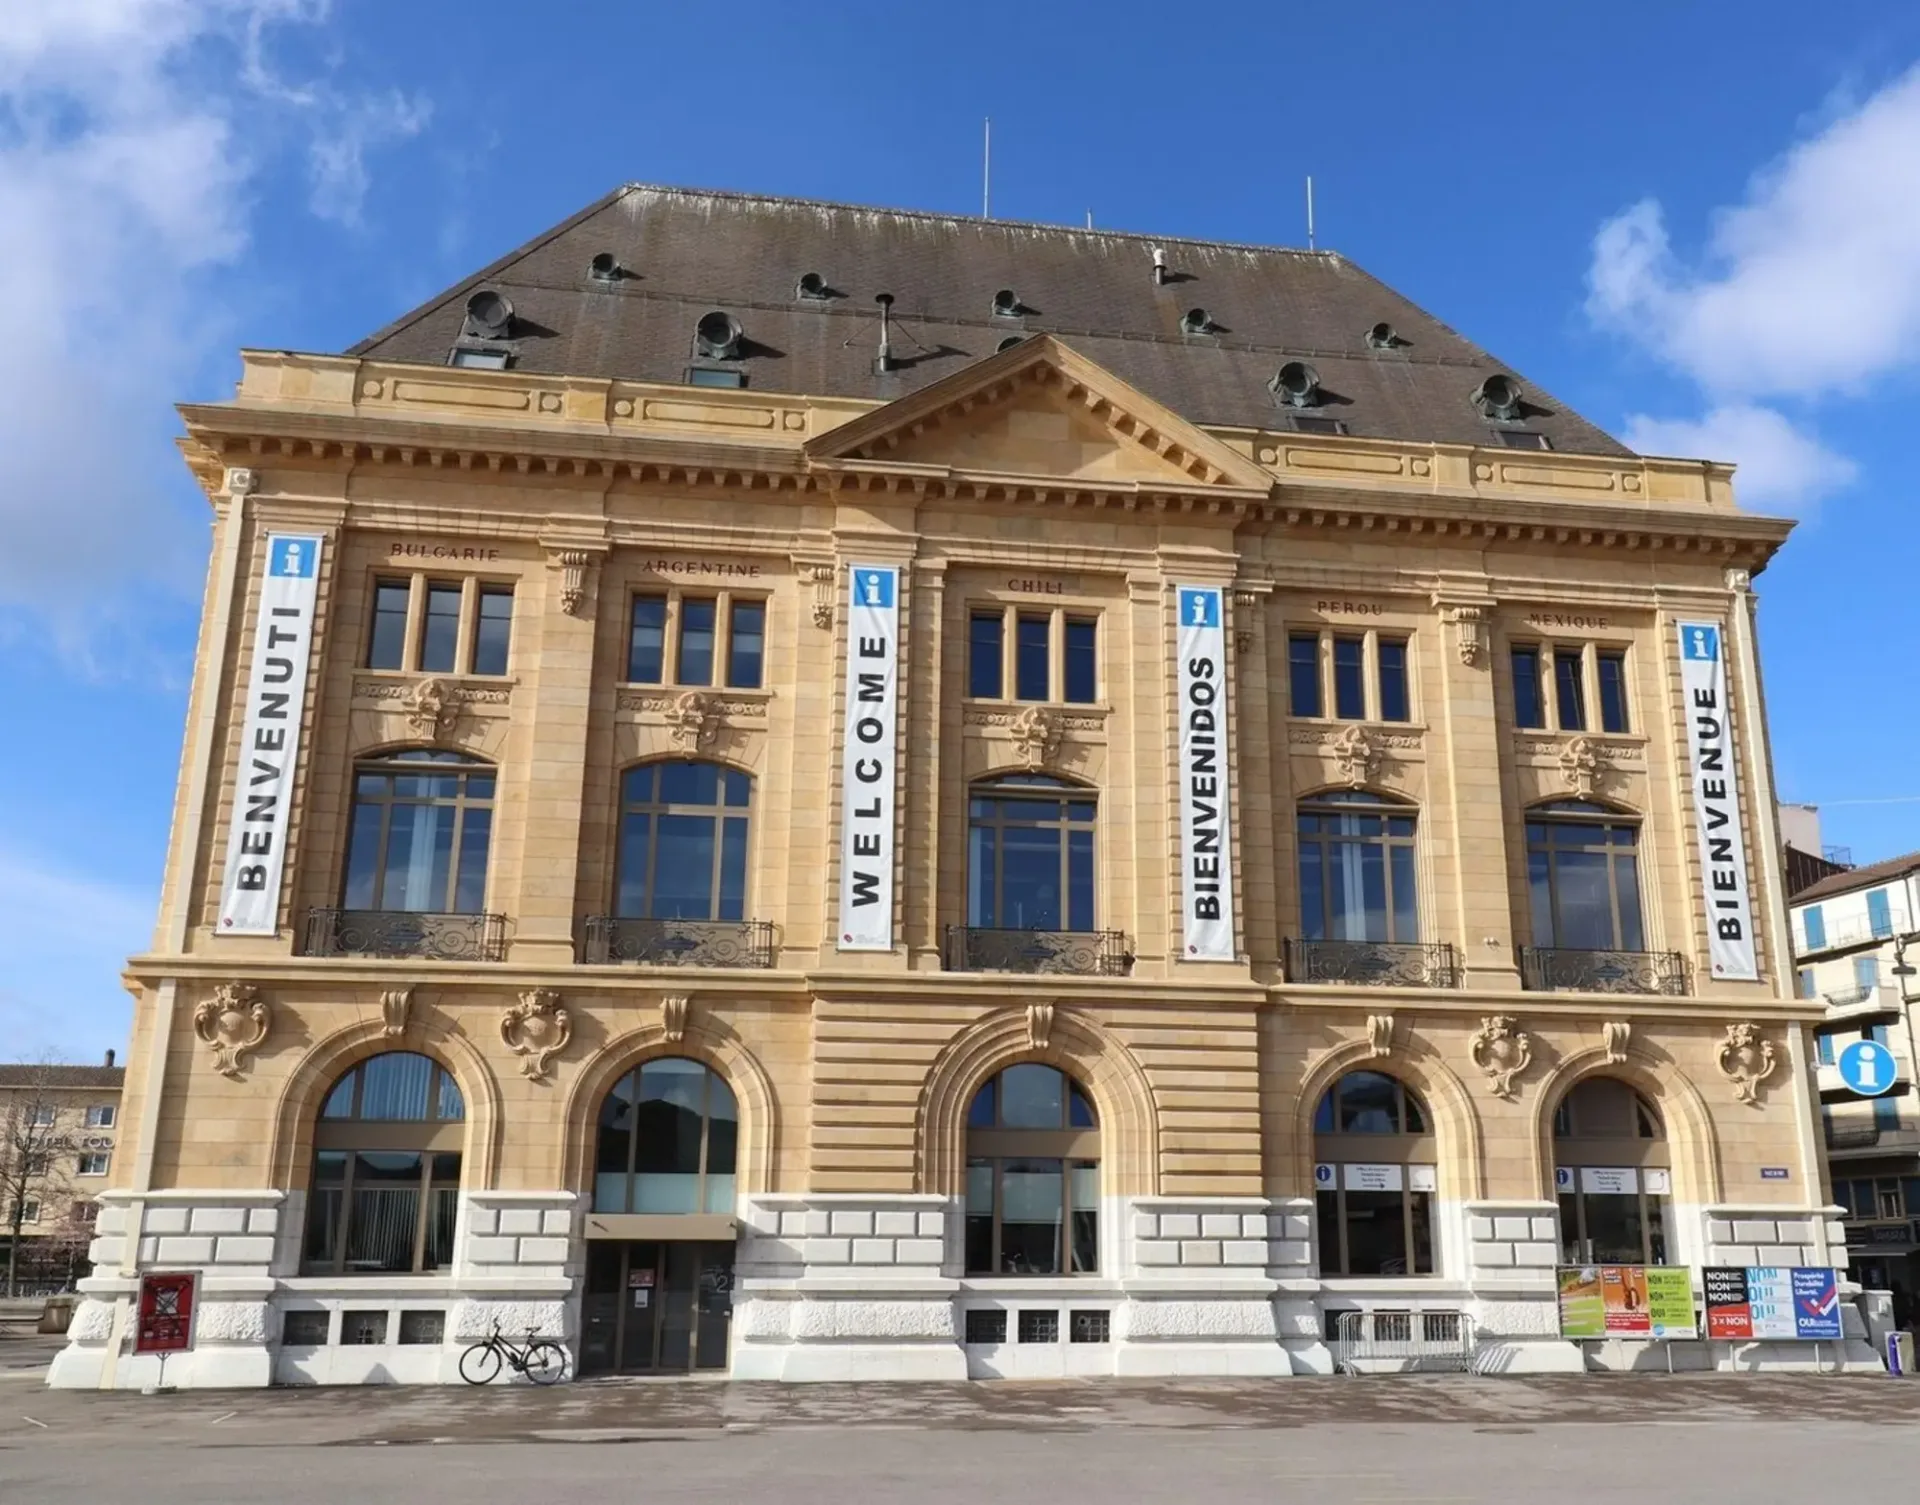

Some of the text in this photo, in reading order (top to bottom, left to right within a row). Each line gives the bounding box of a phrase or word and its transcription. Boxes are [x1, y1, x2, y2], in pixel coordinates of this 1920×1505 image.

[390, 542, 500, 562] BULGARIE
[642, 559, 762, 578] ARGENTINE
[1008, 579, 1063, 594] CHILI
[1317, 600, 1383, 616] PEROU
[1529, 612, 1608, 630] MEXIQUE
[236, 606, 301, 892] BENVENUTI
[852, 636, 886, 908] WELCOME
[1189, 657, 1221, 921] BIENVENIDOS
[1694, 687, 1744, 942] BIENVENUE
[1707, 1272, 1729, 1281] NON
[1708, 1282, 1730, 1291] NON
[1709, 1292, 1731, 1301] NON
[1712, 1317, 1718, 1326] 3
[1726, 1316, 1748, 1326] NON
